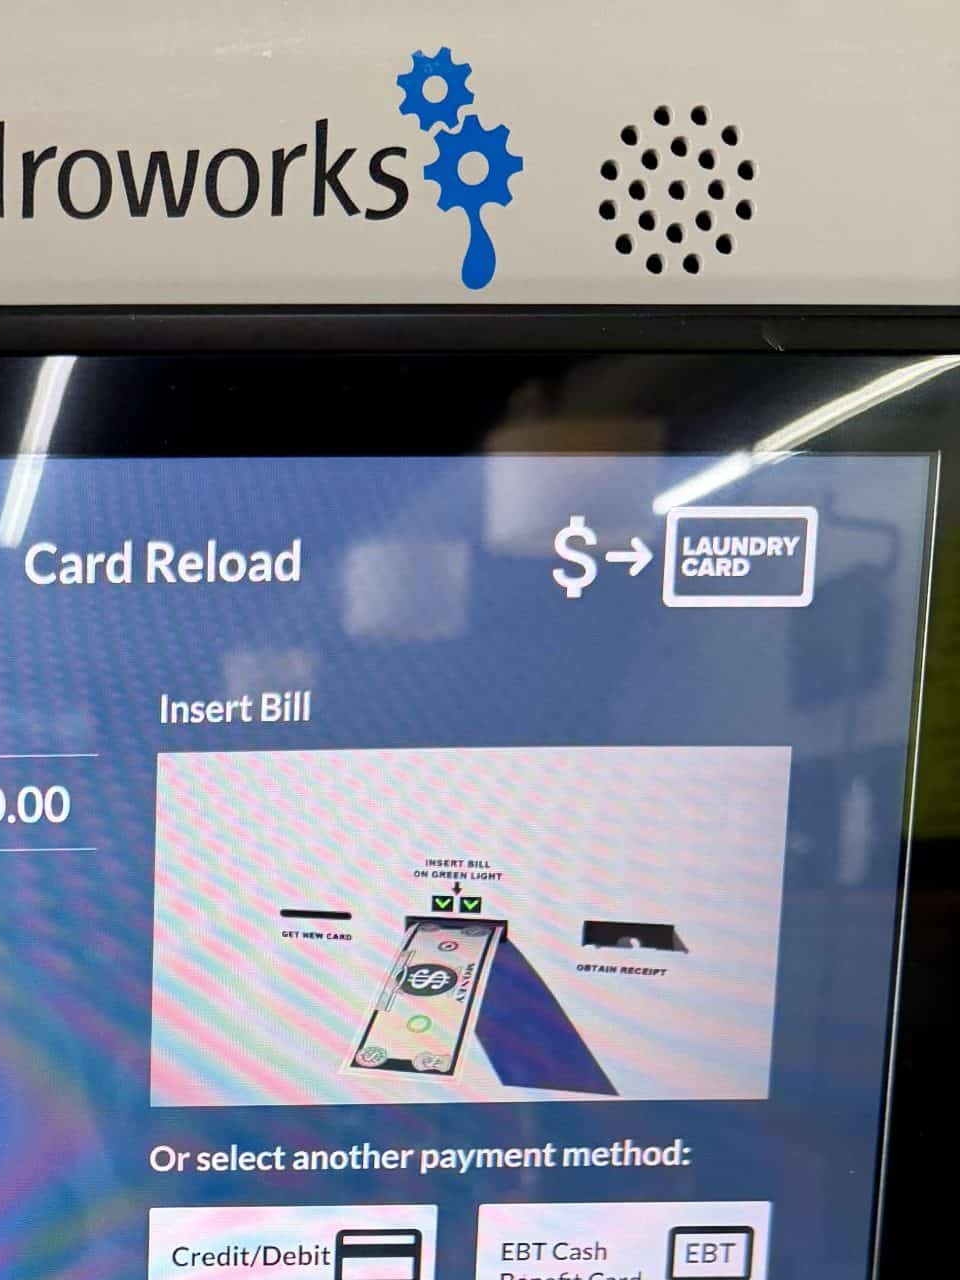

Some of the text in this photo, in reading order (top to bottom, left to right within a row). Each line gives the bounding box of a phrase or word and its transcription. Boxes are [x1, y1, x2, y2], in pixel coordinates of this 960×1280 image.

[682, 536, 800, 556] LAUNDRY
[24, 539, 302, 585] Card Reload
[681, 557, 750, 576] CARD
[159, 692, 311, 725] Insert Bill
[425, 859, 491, 869] INSERT BILL
[413, 870, 503, 881] ON GREEN LIGHT
[281, 930, 352, 941] GET NEW CARD
[576, 963, 668, 978] OBTAIN RECEIPT
[150, 1139, 691, 1174] Or select another payment method:
[172, 1245, 331, 1268] Credit/Debit
[501, 1241, 608, 1261] EBT Cash
[685, 1242, 737, 1264] EBT
